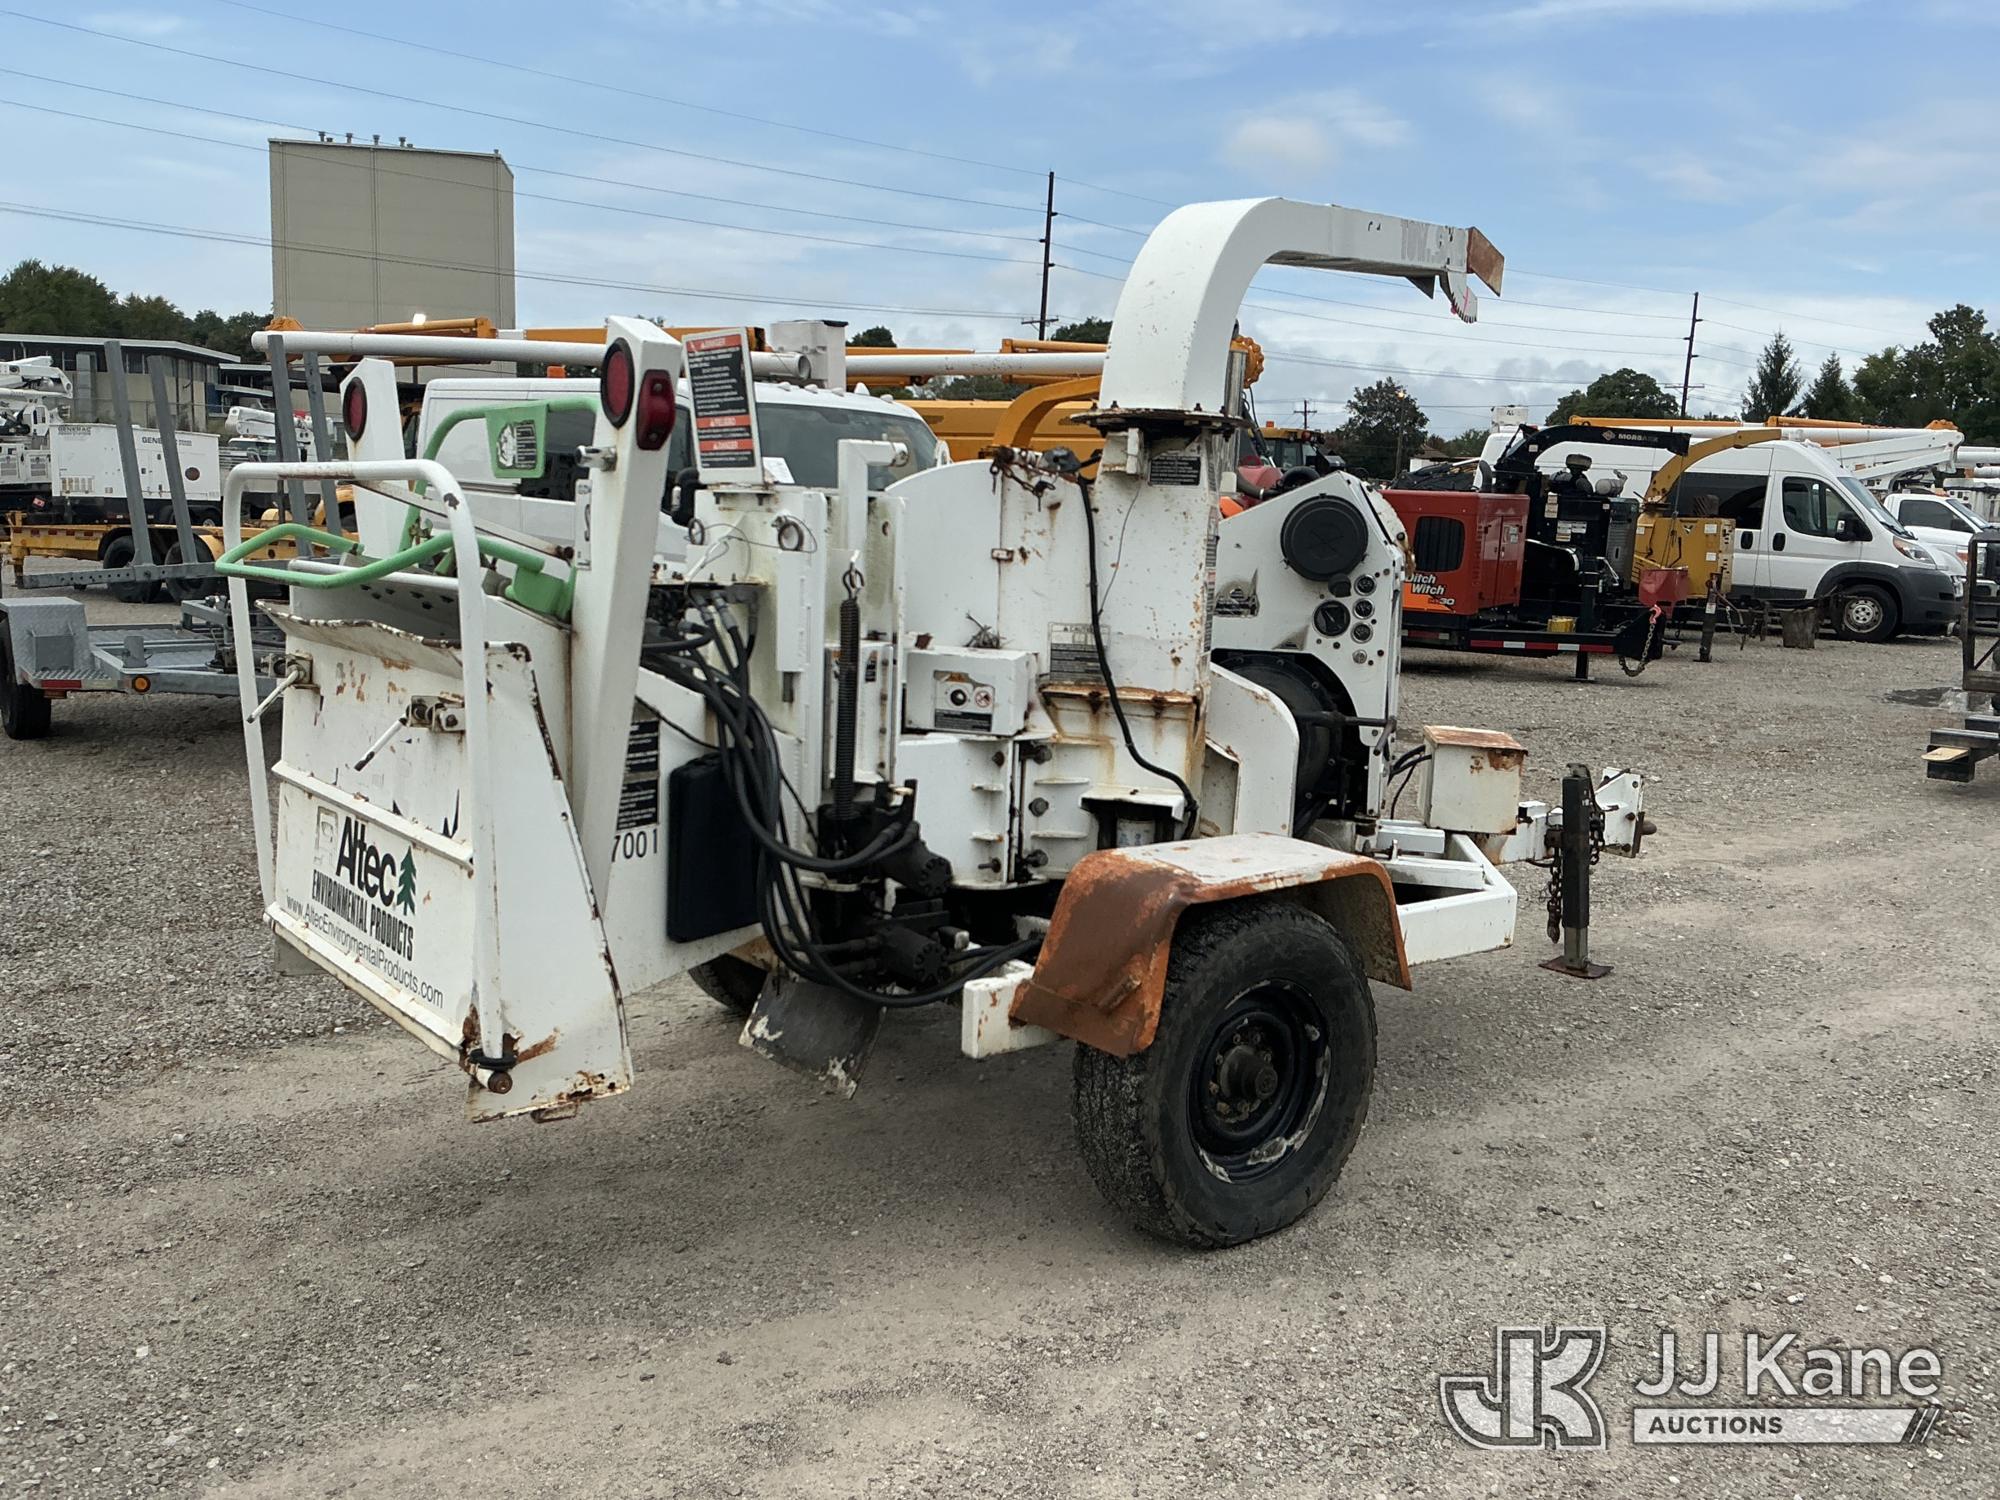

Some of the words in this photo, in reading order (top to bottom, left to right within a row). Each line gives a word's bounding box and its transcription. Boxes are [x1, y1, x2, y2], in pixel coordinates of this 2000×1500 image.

[1412, 583, 1445, 595] Witch
[336, 816, 397, 907] Altec
[312, 869, 368, 934] ENVIRONMENTAL
[369, 904, 414, 962] PRODUCTS
